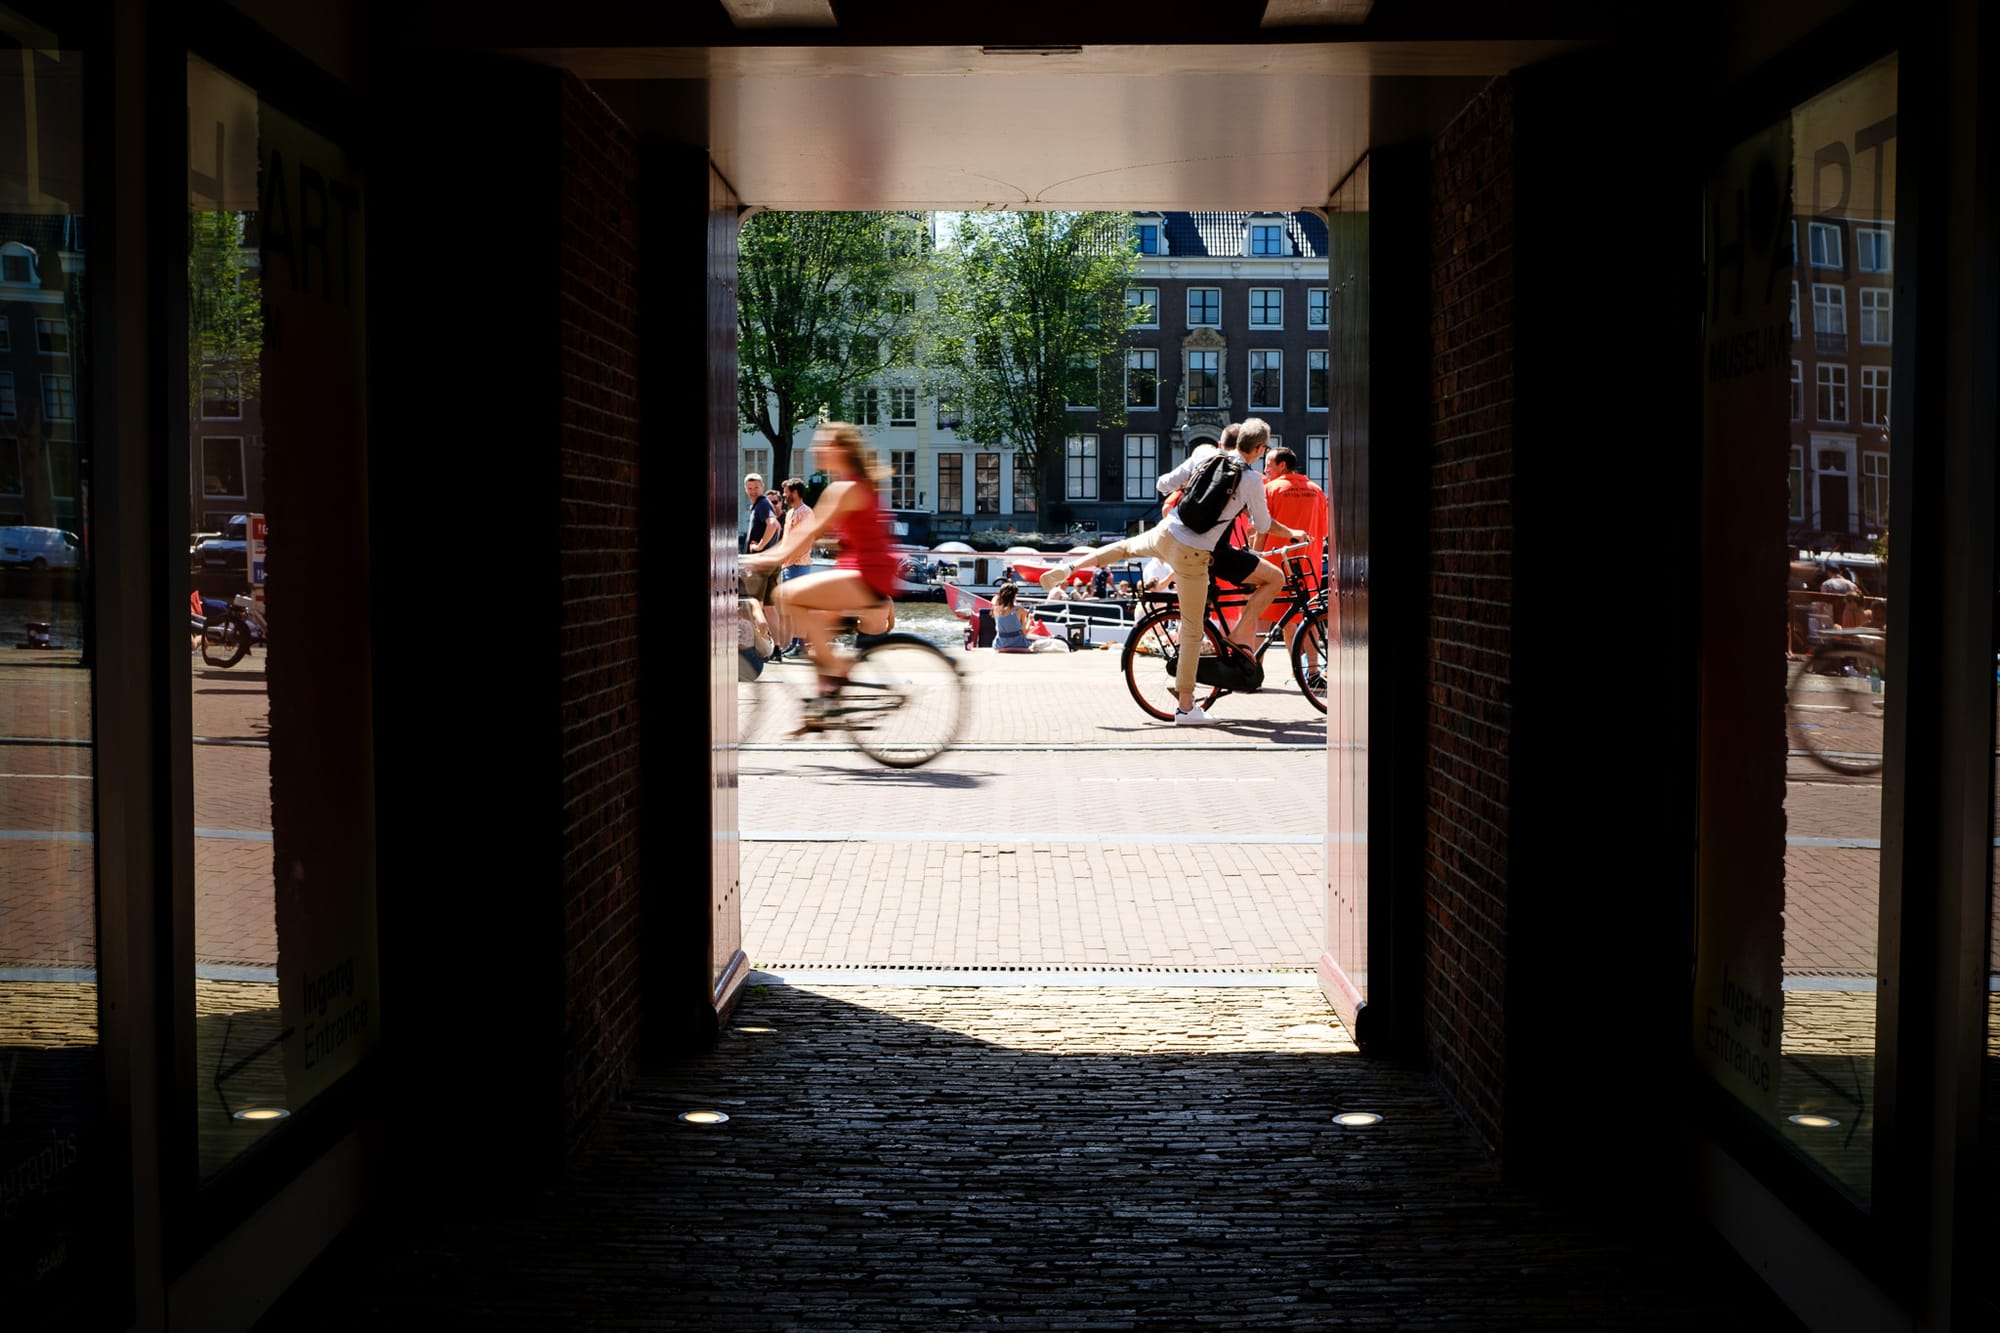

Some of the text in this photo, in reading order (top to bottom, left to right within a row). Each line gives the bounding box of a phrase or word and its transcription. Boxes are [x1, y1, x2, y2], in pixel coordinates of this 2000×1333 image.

[303, 957, 354, 1015] Ingang
[1721, 966, 1773, 1048] Ingang
[304, 999, 369, 1071] Entrance
[1705, 1007, 1770, 1093] Entrance
